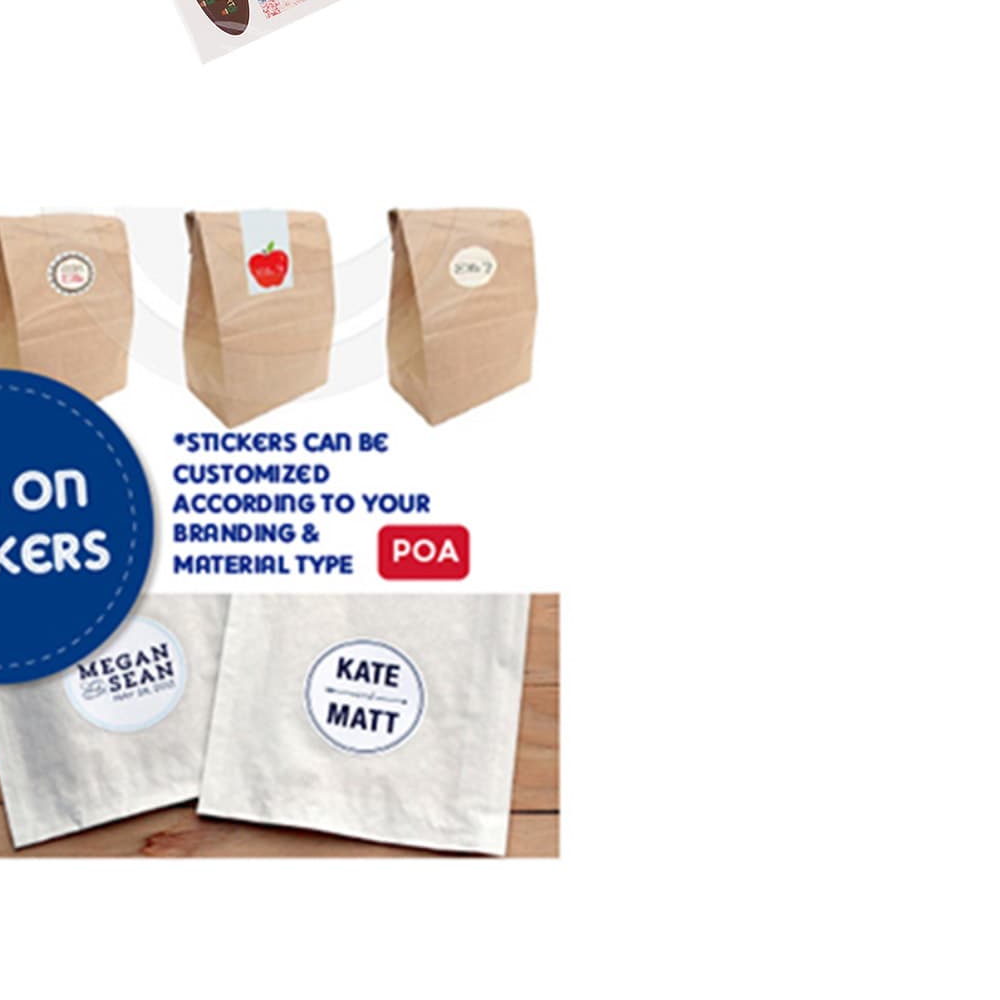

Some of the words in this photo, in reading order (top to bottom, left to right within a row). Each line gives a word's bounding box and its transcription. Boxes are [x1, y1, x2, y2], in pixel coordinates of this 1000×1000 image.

[77, 643, 170, 680] MEGAN
[108, 661, 175, 693] SEAN
[336, 656, 401, 688] KATE
[326, 702, 400, 734] MATT
